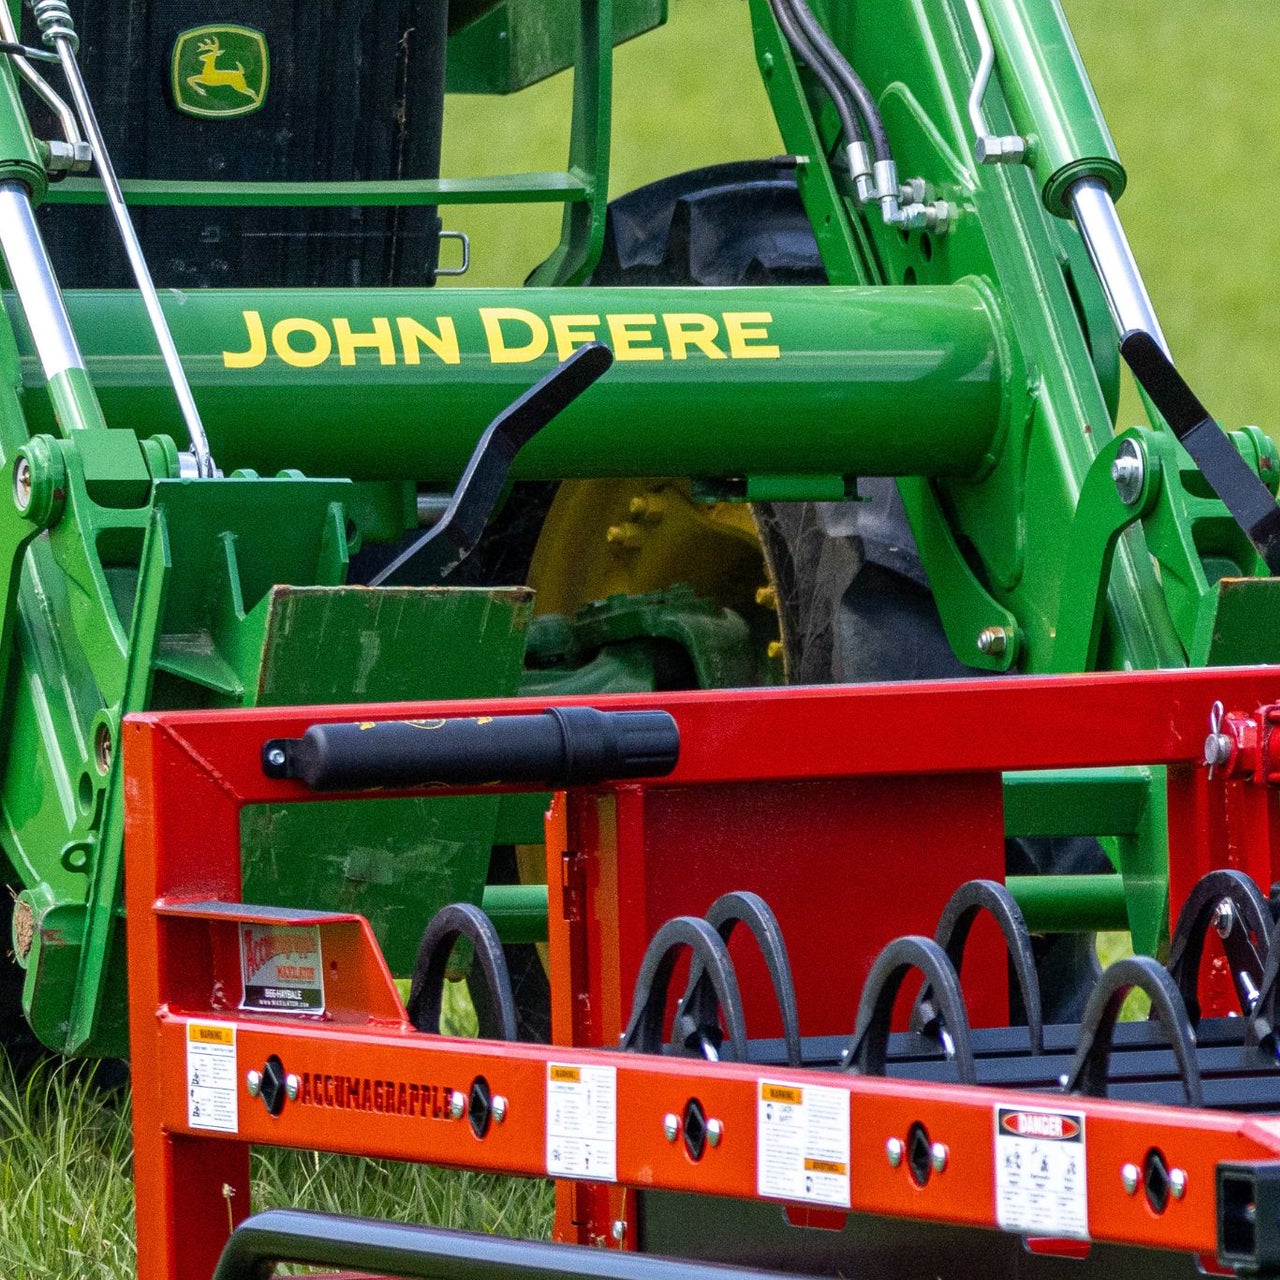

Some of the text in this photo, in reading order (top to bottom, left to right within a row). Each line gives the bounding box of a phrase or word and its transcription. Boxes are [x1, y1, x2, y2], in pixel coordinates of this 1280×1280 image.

[222, 307, 781, 368] JOHN DEERE
[301, 1072, 453, 1120] ACCUMAGRAPPLE
[1018, 1113, 1063, 1137] DANGER
